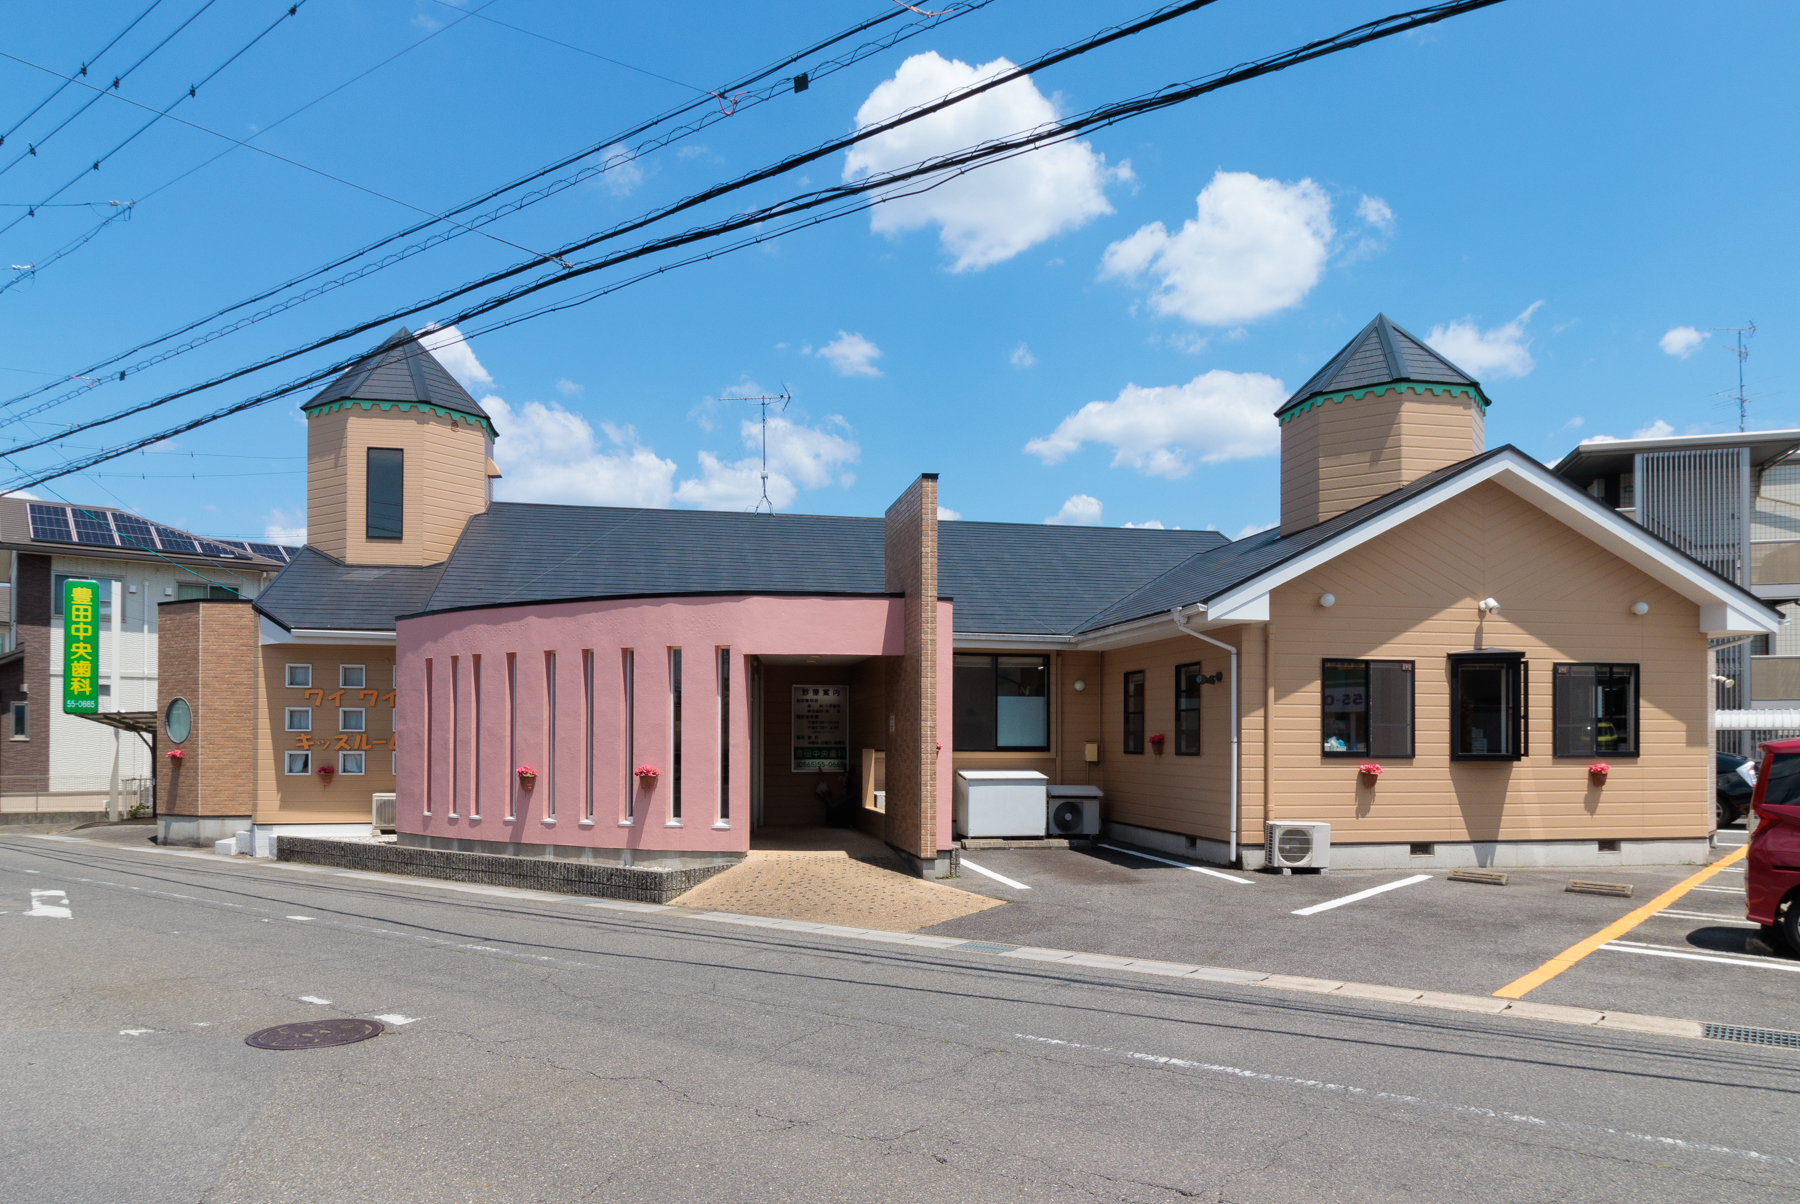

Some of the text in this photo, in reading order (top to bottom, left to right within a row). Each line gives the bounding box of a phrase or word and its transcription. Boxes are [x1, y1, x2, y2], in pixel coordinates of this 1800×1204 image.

[71, 587, 92, 695] 豊田中央歯科
[66, 700, 95, 708] 55-0665
